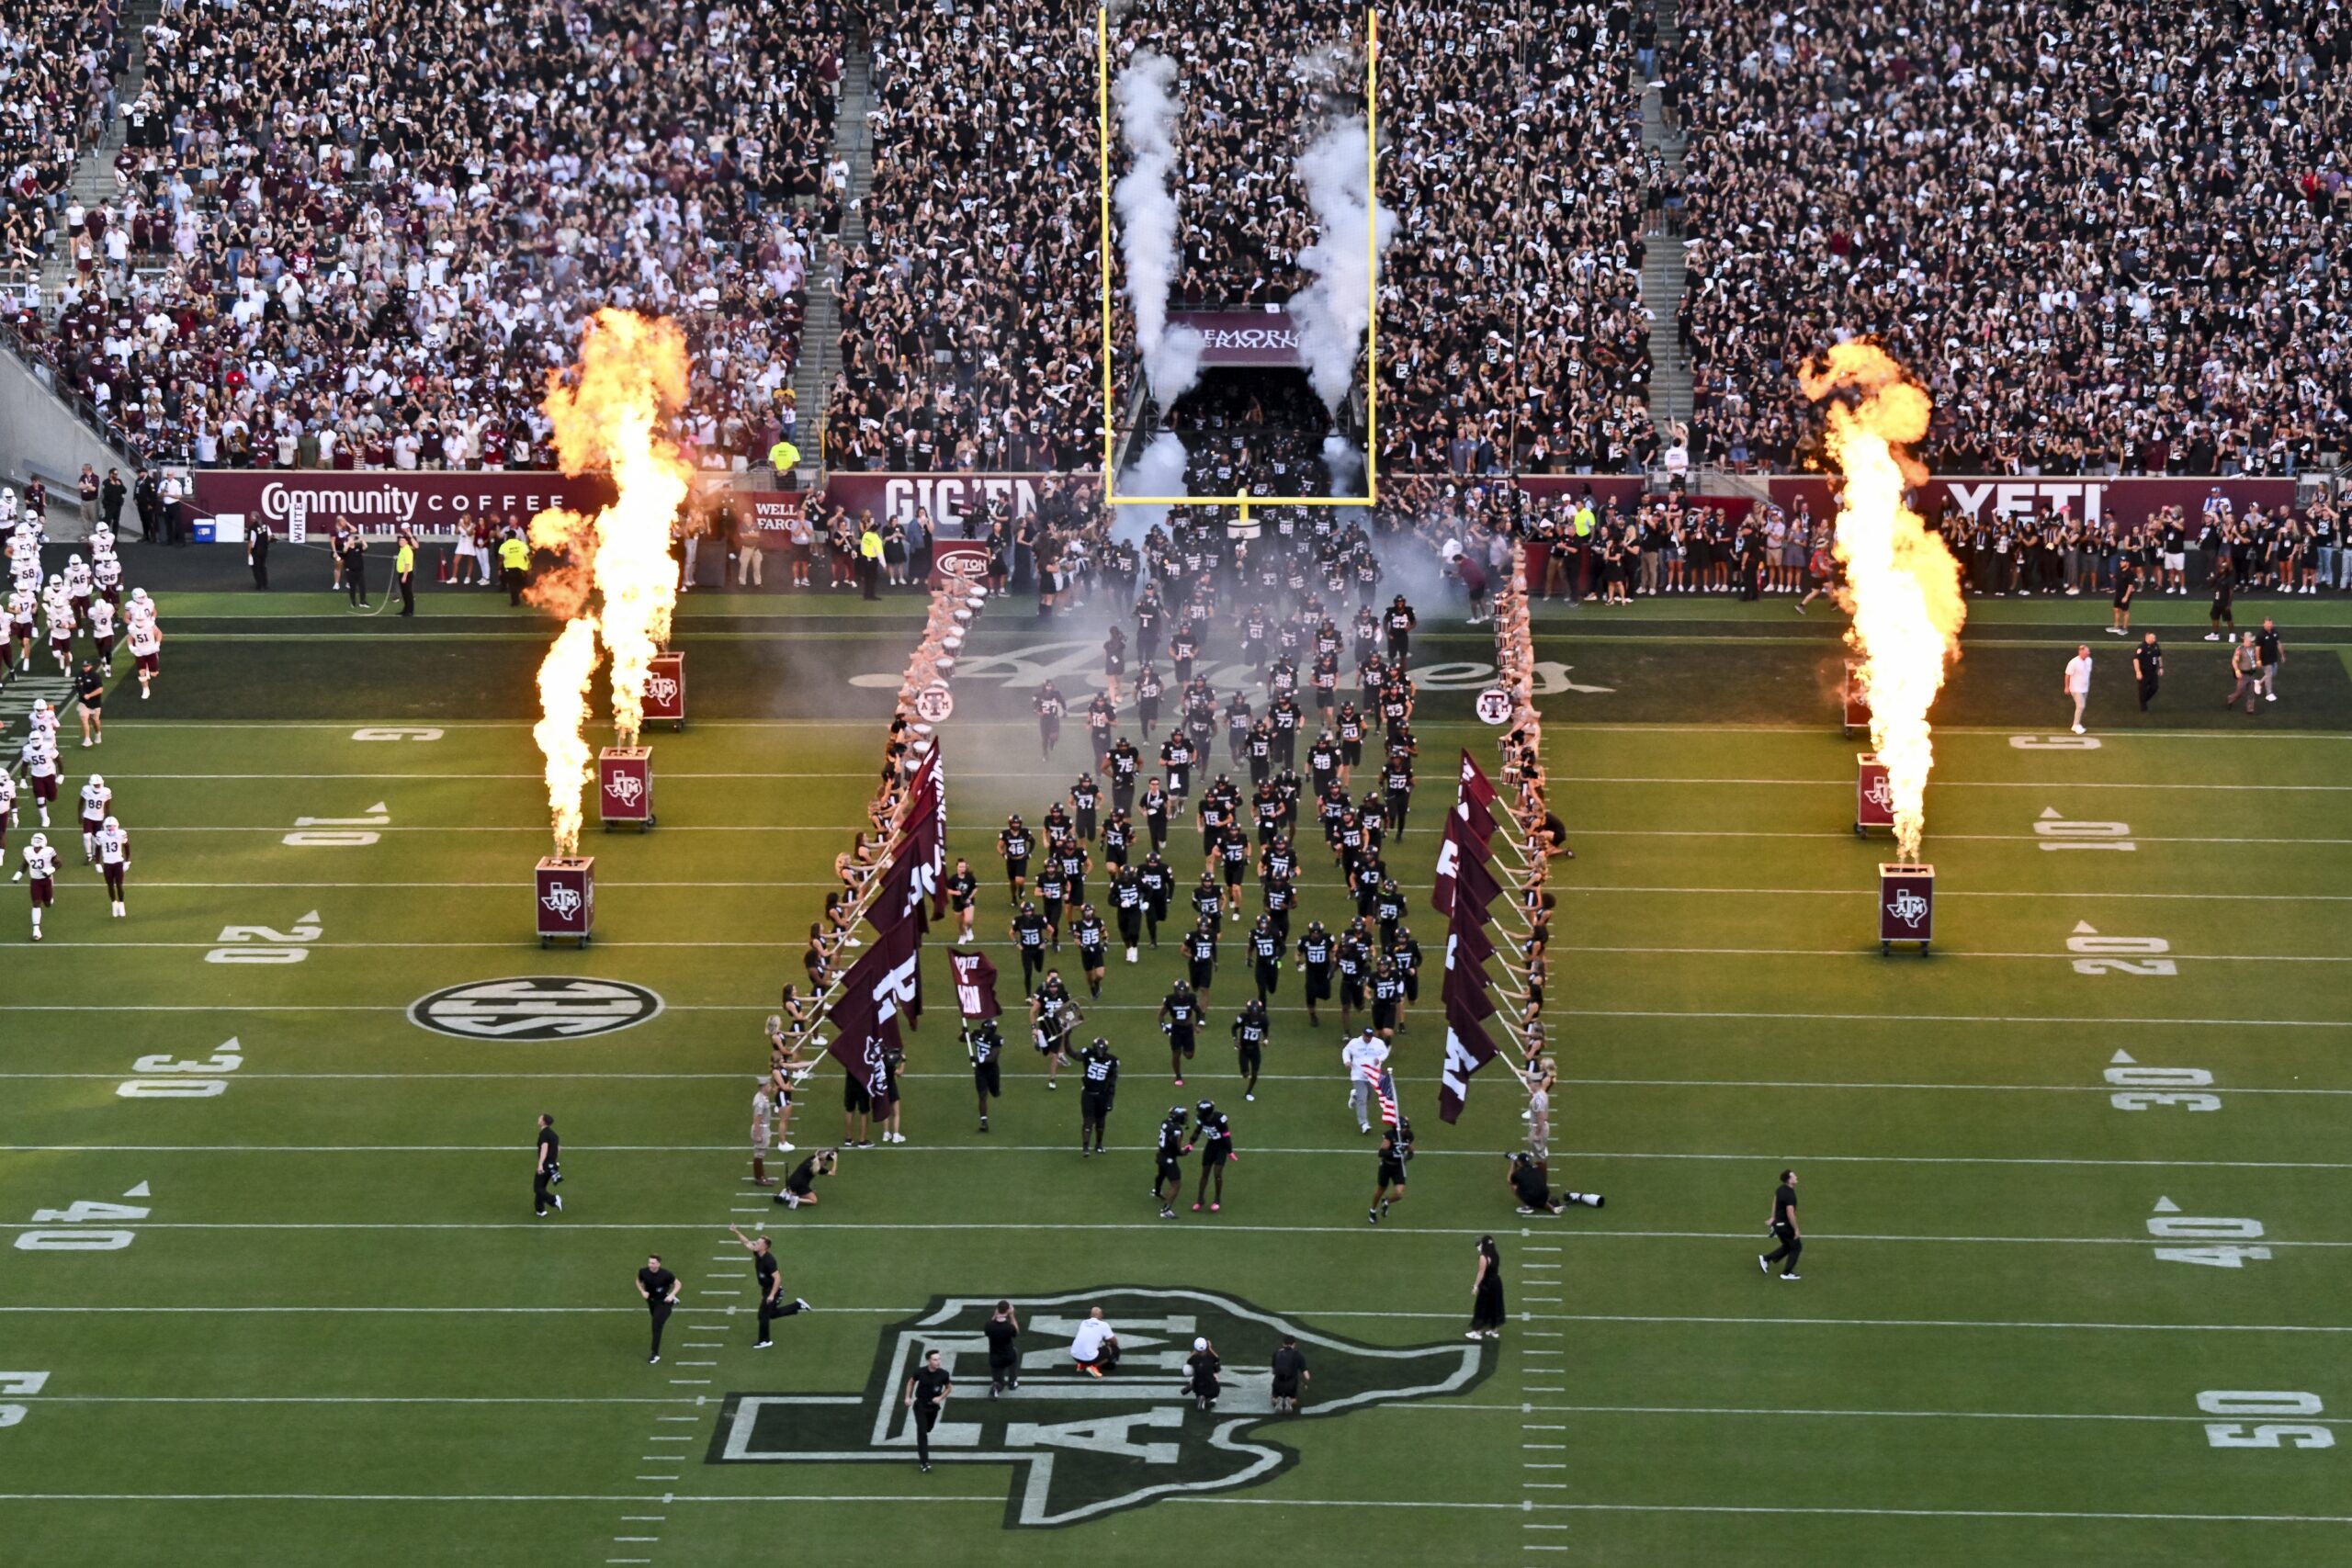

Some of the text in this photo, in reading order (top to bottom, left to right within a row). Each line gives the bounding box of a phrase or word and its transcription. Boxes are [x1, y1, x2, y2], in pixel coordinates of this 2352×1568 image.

[1204, 329, 1303, 340] EMORI
[261, 482, 563, 521] Community COFFEE
[1947, 483, 2100, 528] YETI
[755, 503, 797, 516] WELL
[294, 503, 302, 542] WHITE
[1199, 530, 1206, 539] 9
[1279, 525, 1293, 535] 98
[1119, 561, 1131, 570] 75
[22, 569, 35, 580] 58
[74, 574, 86, 585] 46
[1360, 571, 1373, 581] 22
[55, 618, 62, 627] 2
[100, 617, 107, 626] 9
[137, 633, 149, 642] 51
[1178, 648, 1190, 657] 15
[1365, 675, 1382, 685] 45
[1277, 717, 1293, 728] 73
[1343, 728, 1358, 738] 20
[1253, 747, 1267, 756] 13
[31, 754, 47, 765] 55
[1171, 753, 1188, 763] 58
[1118, 763, 1133, 773] 76
[1389, 780, 1406, 789] 50
[88, 799, 103, 809] 88
[1078, 798, 1093, 809] 47
[1327, 807, 1341, 817] 34
[1204, 815, 1218, 825] 19
[1363, 819, 1381, 829] 24
[282, 815, 390, 846] 10
[1050, 830, 1062, 840] 41
[2034, 820, 2137, 851] 10
[105, 842, 118, 852] 13
[1343, 837, 1360, 846] 40
[1009, 844, 1024, 854] 46
[30, 859, 45, 870] 23
[1064, 864, 1079, 874] 81
[1362, 873, 1379, 884] 43
[1270, 897, 1283, 909] 15
[1023, 933, 1040, 944] 38
[1082, 933, 1099, 944] 85
[204, 925, 322, 964] 20
[1258, 943, 1273, 956] 10
[1197, 947, 1210, 958] 16
[1308, 951, 1325, 963] 60
[2066, 937, 2177, 976] 20
[1396, 957, 1411, 968] 17
[1377, 987, 1395, 998] 87
[428, 981, 643, 1034] SEC
[117, 1054, 243, 1098] 30
[1088, 1066, 1107, 1080] 55
[2103, 1067, 2222, 1111] 30
[14, 1201, 152, 1250] 40
[2146, 1217, 2272, 1268] 40
[2196, 1391, 2335, 1449] 50
